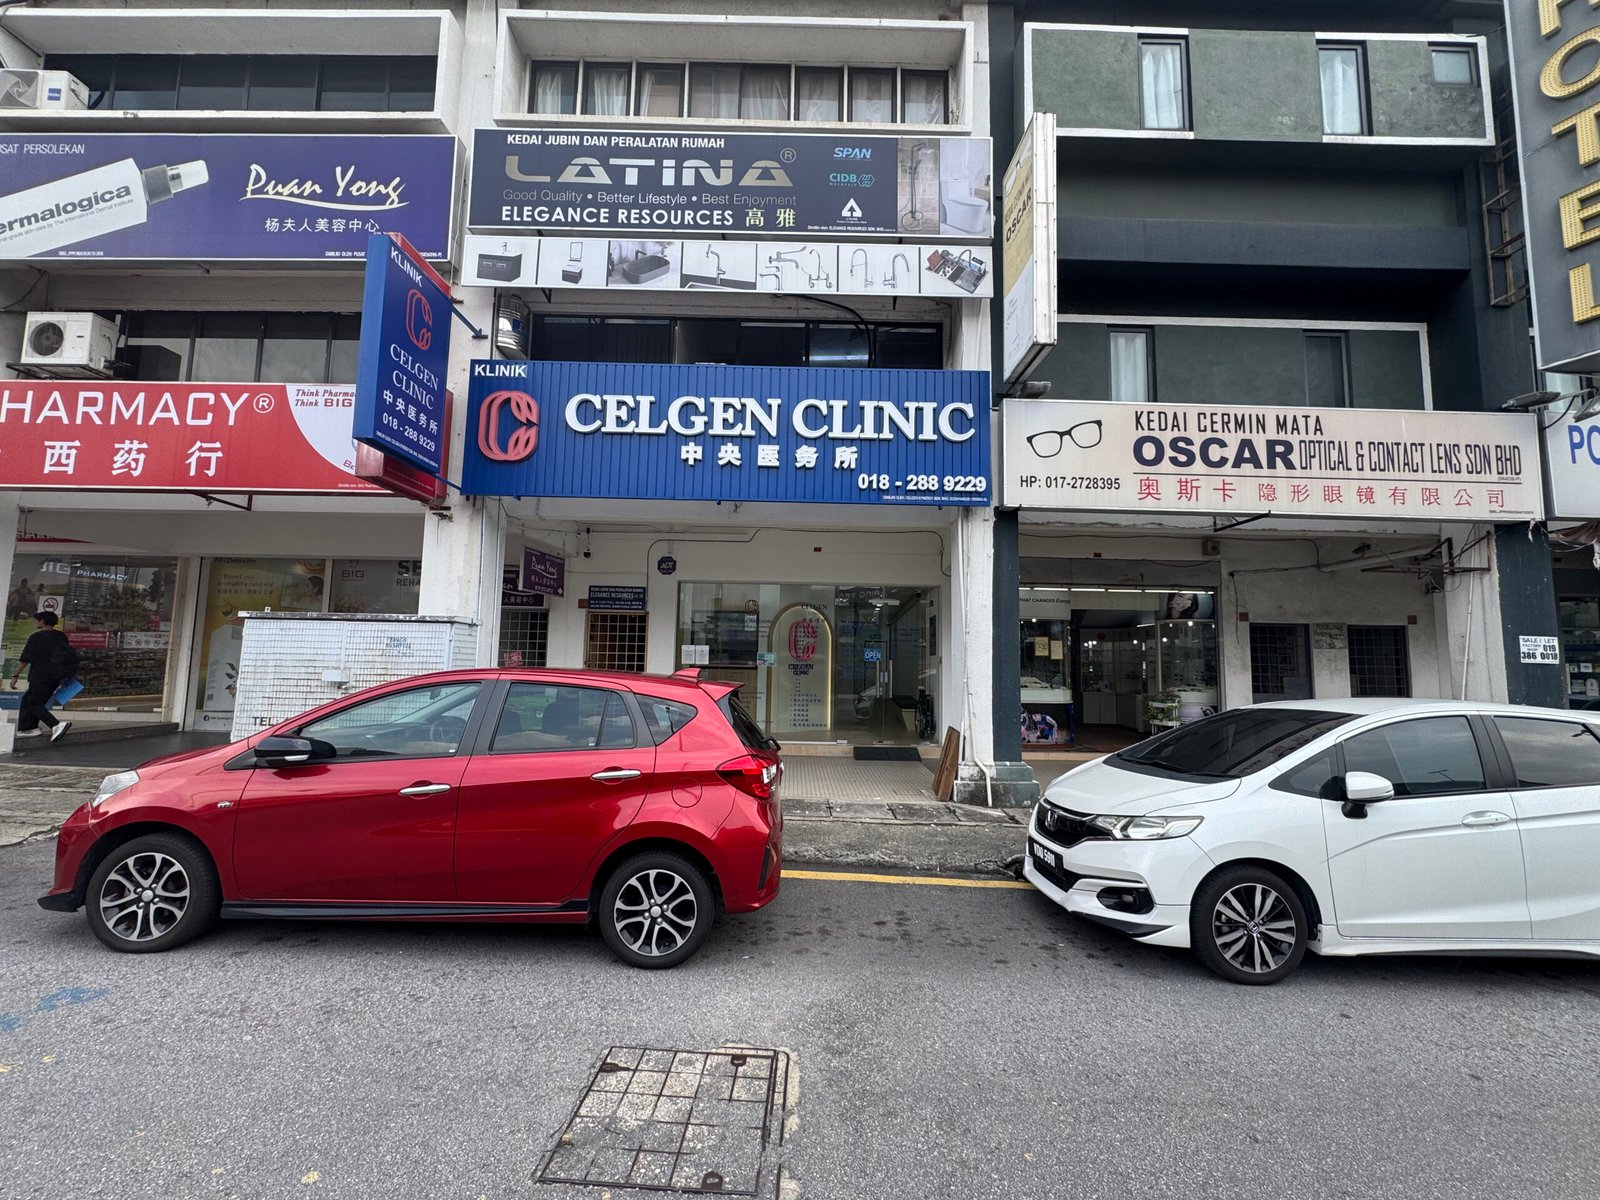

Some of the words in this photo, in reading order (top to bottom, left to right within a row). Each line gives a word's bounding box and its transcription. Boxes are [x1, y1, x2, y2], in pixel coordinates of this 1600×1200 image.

[23, 144, 86, 154] PERSOLEKAN
[507, 134, 542, 146] KEDAI
[544, 135, 580, 146] JUBIN
[583, 136, 608, 147] DAN
[611, 136, 679, 148] PERALATAN
[682, 137, 725, 148] RUMAH
[833, 147, 873, 160] SPAN
[246, 163, 323, 198] Puan
[334, 165, 406, 208] Yong
[829, 173, 858, 183] CIDB
[502, 189, 537, 201] Good
[540, 190, 583, 203] Quality
[597, 191, 635, 204] Better
[638, 193, 688, 206] Lifestyle
[702, 193, 729, 205] Best
[733, 193, 797, 208] Enjoyment
[502, 206, 610, 223] ELEGANCE
[618, 209, 734, 226] RESOURCES
[745, 207, 798, 228] 高雅
[1006, 187, 1032, 242] OSCAR
[265, 217, 380, 233] 杨夫人美容中心
[390, 245, 424, 289] KLINIK
[389, 343, 440, 393] CELGEN
[474, 364, 528, 378] KLINIK
[296, 388, 320, 398] Think
[321, 389, 357, 398] Pharma
[391, 369, 435, 411] CLINIC
[294, 398, 320, 407] Think
[323, 398, 354, 408] BIG
[382, 389, 439, 436] 中央医务所
[564, 393, 782, 439] CELGEN
[792, 398, 976, 443] CLINIC
[1134, 411, 1189, 433] KEDAI
[1197, 412, 1267, 435] CERMIN
[1275, 414, 1324, 436] MATA
[382, 412, 399, 430] 018
[404, 425, 418, 442] 288
[418, 434, 436, 452] 9229
[43, 440, 224, 478] 西药行
[680, 441, 859, 470] 中央医务所
[1133, 435, 1297, 471] OSCAR
[1300, 439, 1352, 472] OPTICAL
[1355, 441, 1364, 472] &
[1369, 441, 1426, 474] CONTACT
[1430, 442, 1462, 475] LENS
[1466, 444, 1492, 475] SDN
[1496, 445, 1523, 476] BHD
[858, 473, 890, 490] 018
[906, 474, 939, 491] 288
[943, 475, 988, 493] 9229
[1020, 475, 1042, 489] HP:
[1045, 475, 1122, 491] 017-2728395
[1137, 475, 1505, 508] 奥斯卡隐形眼镜有限公司
[1521, 651, 1537, 660] 386
[1540, 652, 1558, 661] 0018
[1542, 644, 1557, 652] 019
